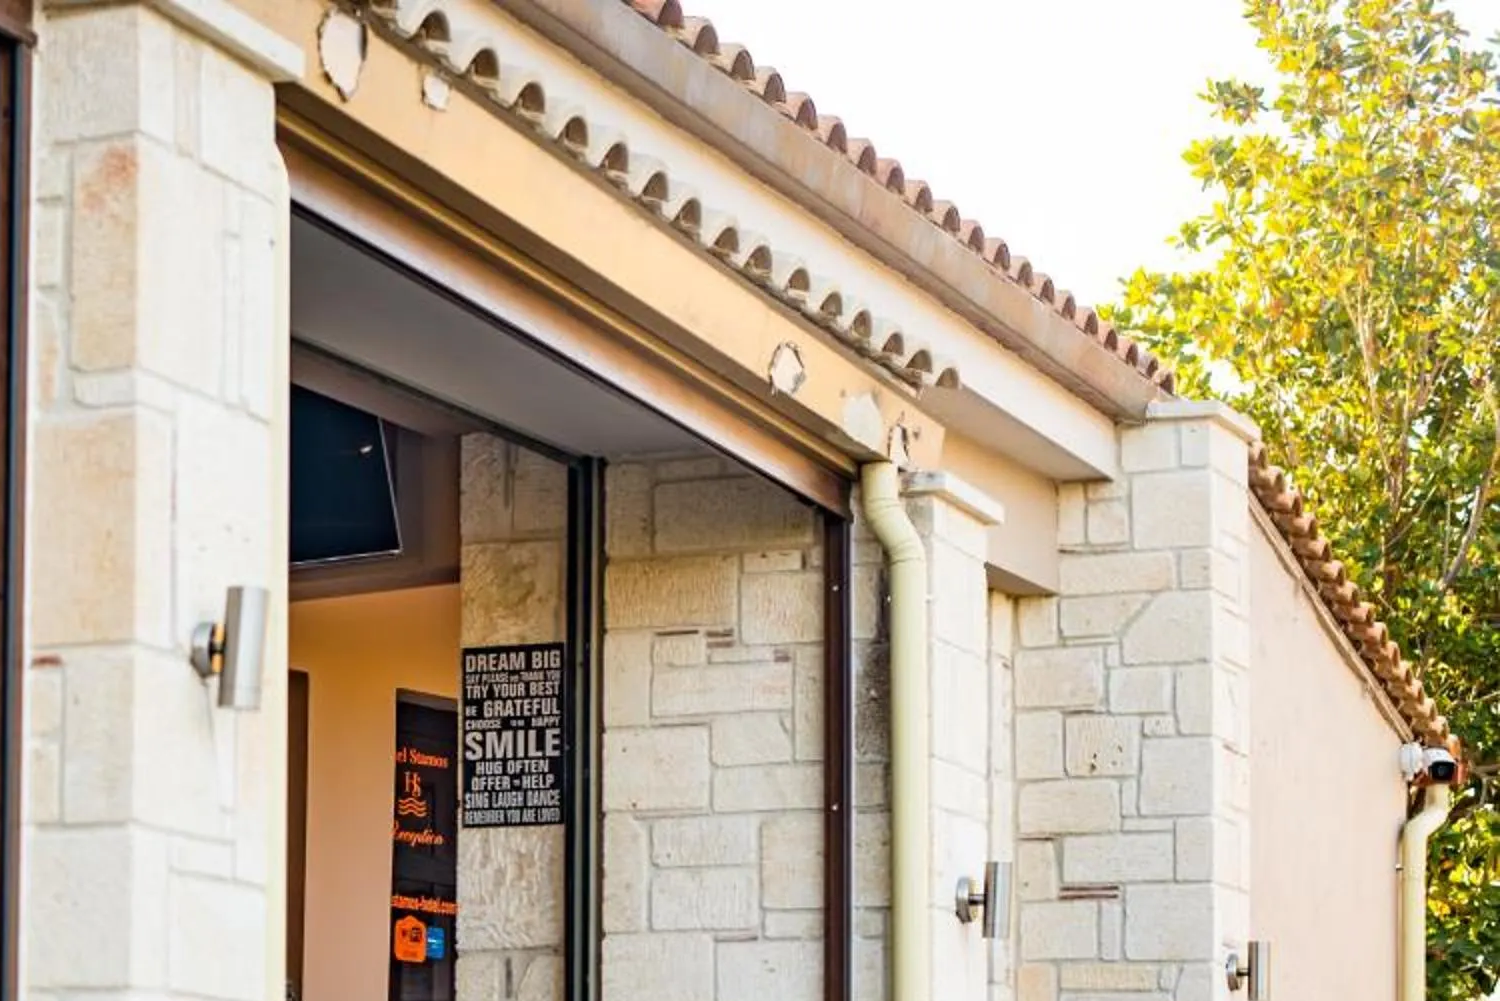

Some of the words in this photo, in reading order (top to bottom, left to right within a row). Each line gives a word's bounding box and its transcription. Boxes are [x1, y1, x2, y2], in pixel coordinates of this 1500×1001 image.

[465, 652, 526, 673] DREAM
[531, 650, 561, 669] BIG
[465, 685, 489, 699] TRY
[493, 683, 525, 698] YOUR
[529, 682, 560, 697] BEST
[465, 706, 477, 717] BE
[483, 698, 561, 718] GRATEFUL
[465, 720, 502, 731] CHOOSE
[531, 717, 561, 727] HAPPY
[465, 730, 561, 760] SMILE
[475, 762, 503, 776] HUG
[507, 759, 549, 775] OFTEN
[471, 777, 511, 791] OFFER
[522, 775, 555, 789] HELP
[465, 793, 490, 809] SING
[491, 792, 525, 808] LAUGH
[526, 790, 561, 806] DANCE
